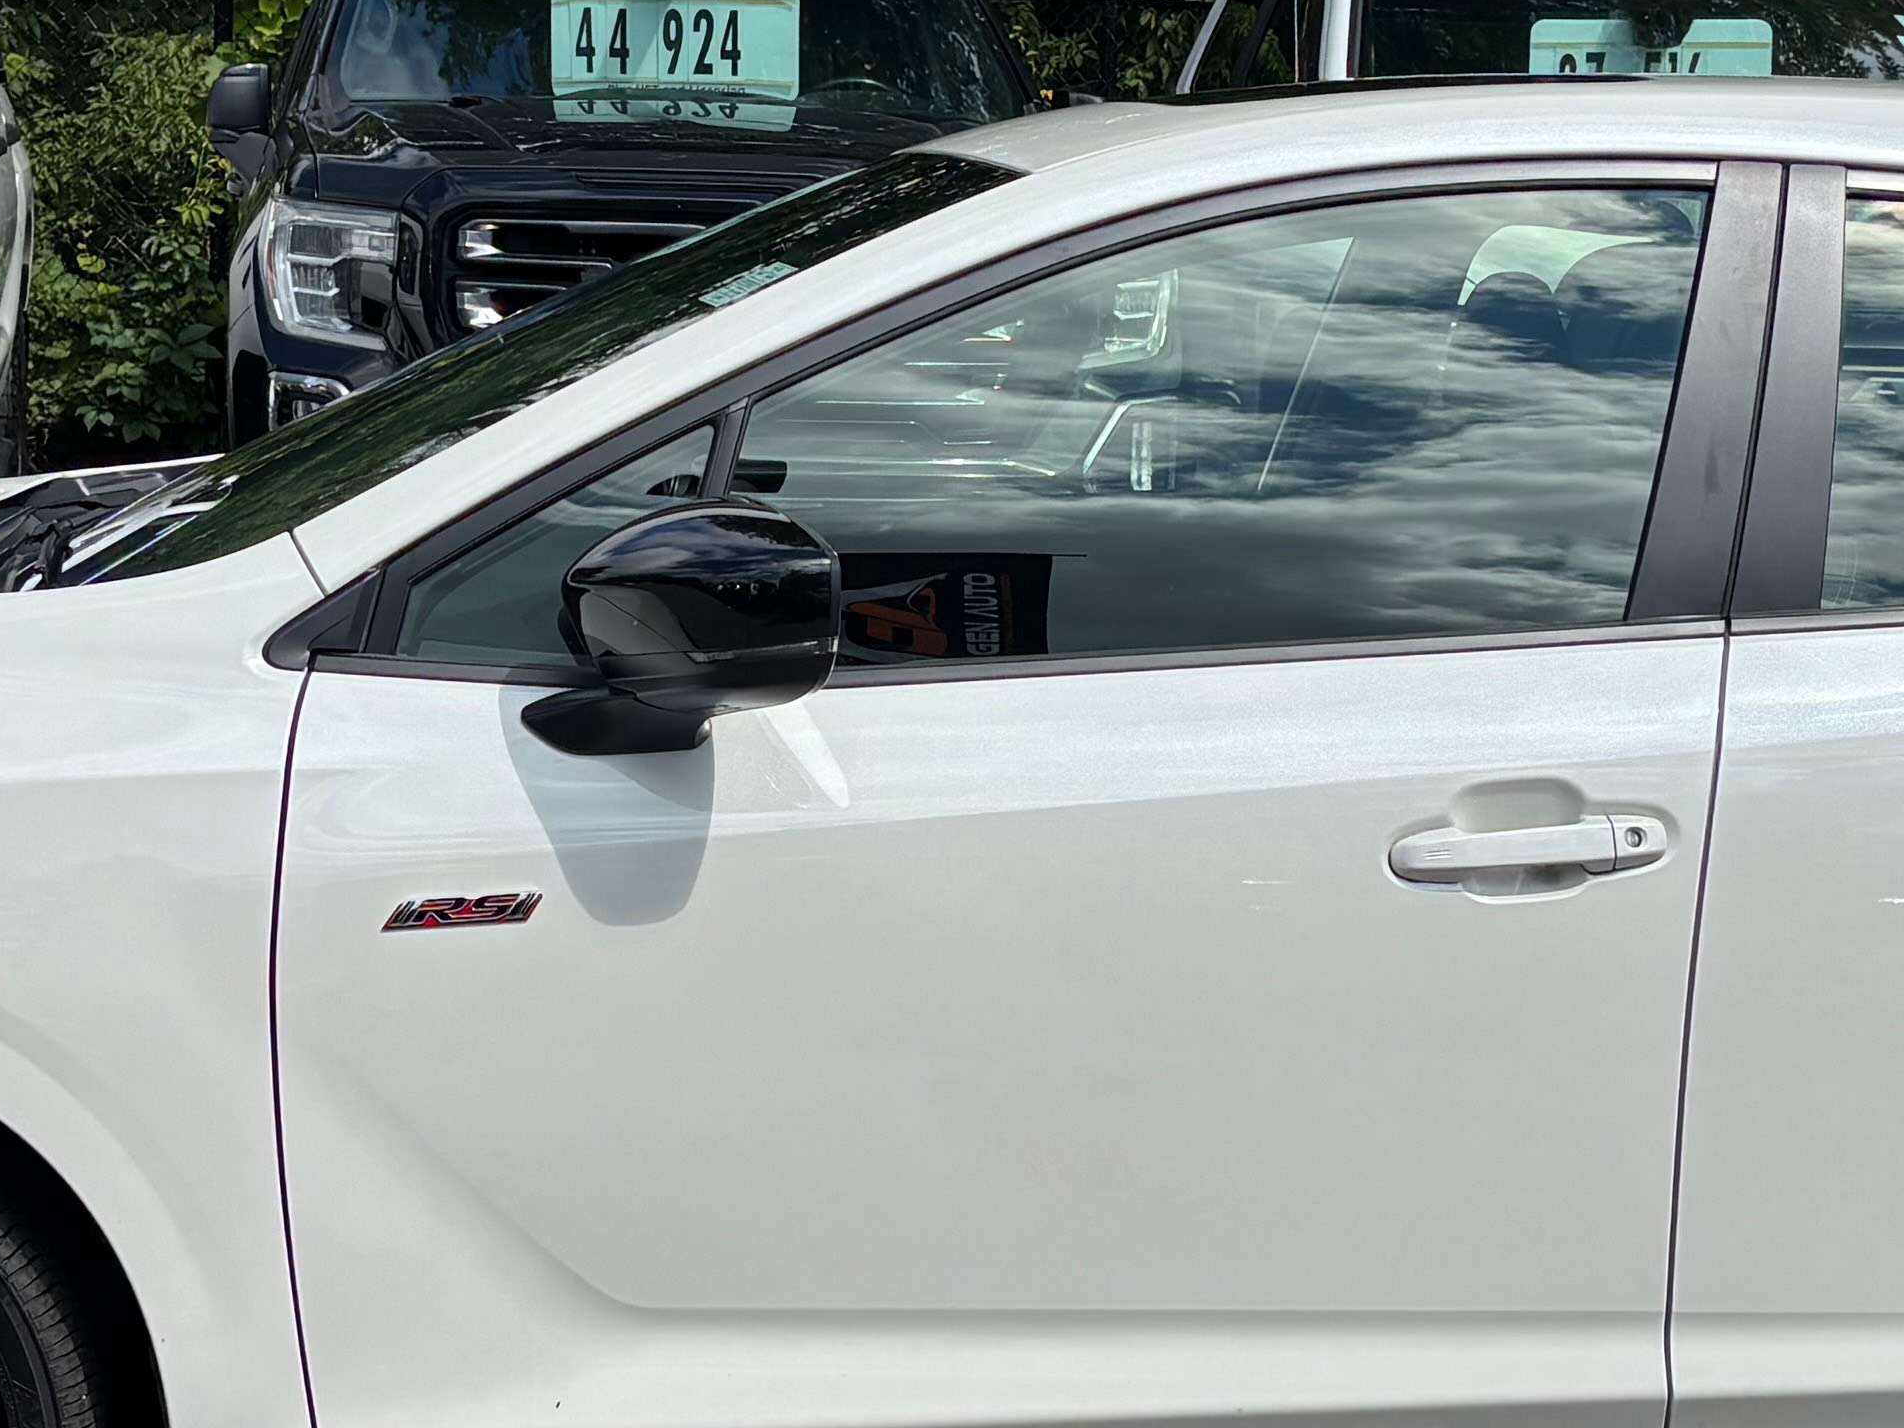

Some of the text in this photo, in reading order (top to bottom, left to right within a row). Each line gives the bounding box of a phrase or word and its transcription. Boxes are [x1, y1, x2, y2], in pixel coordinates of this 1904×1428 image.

[575, 6, 742, 77] 44 924
[962, 572, 1001, 656] GEN AUTO
